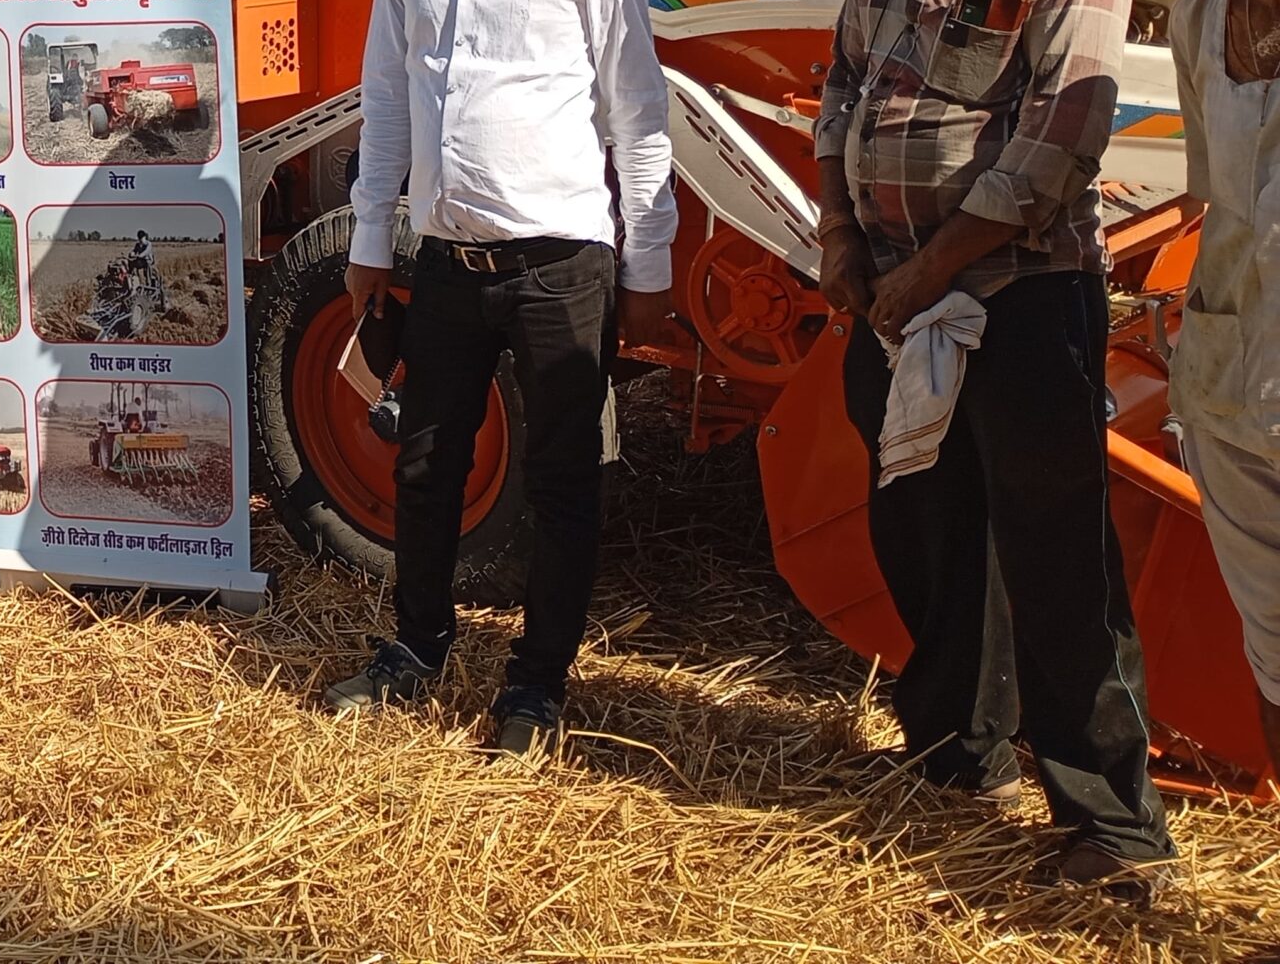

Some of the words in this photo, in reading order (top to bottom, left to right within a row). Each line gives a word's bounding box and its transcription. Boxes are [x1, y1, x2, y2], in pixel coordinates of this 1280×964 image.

[109, 172, 135, 189] बेलर
[89, 353, 114, 371] रीपर
[115, 357, 135, 371] कम
[68, 527, 100, 547] टिलेज
[103, 529, 123, 549] सीड
[126, 536, 145, 550] कम
[210, 537, 233, 559] ड्रिल
